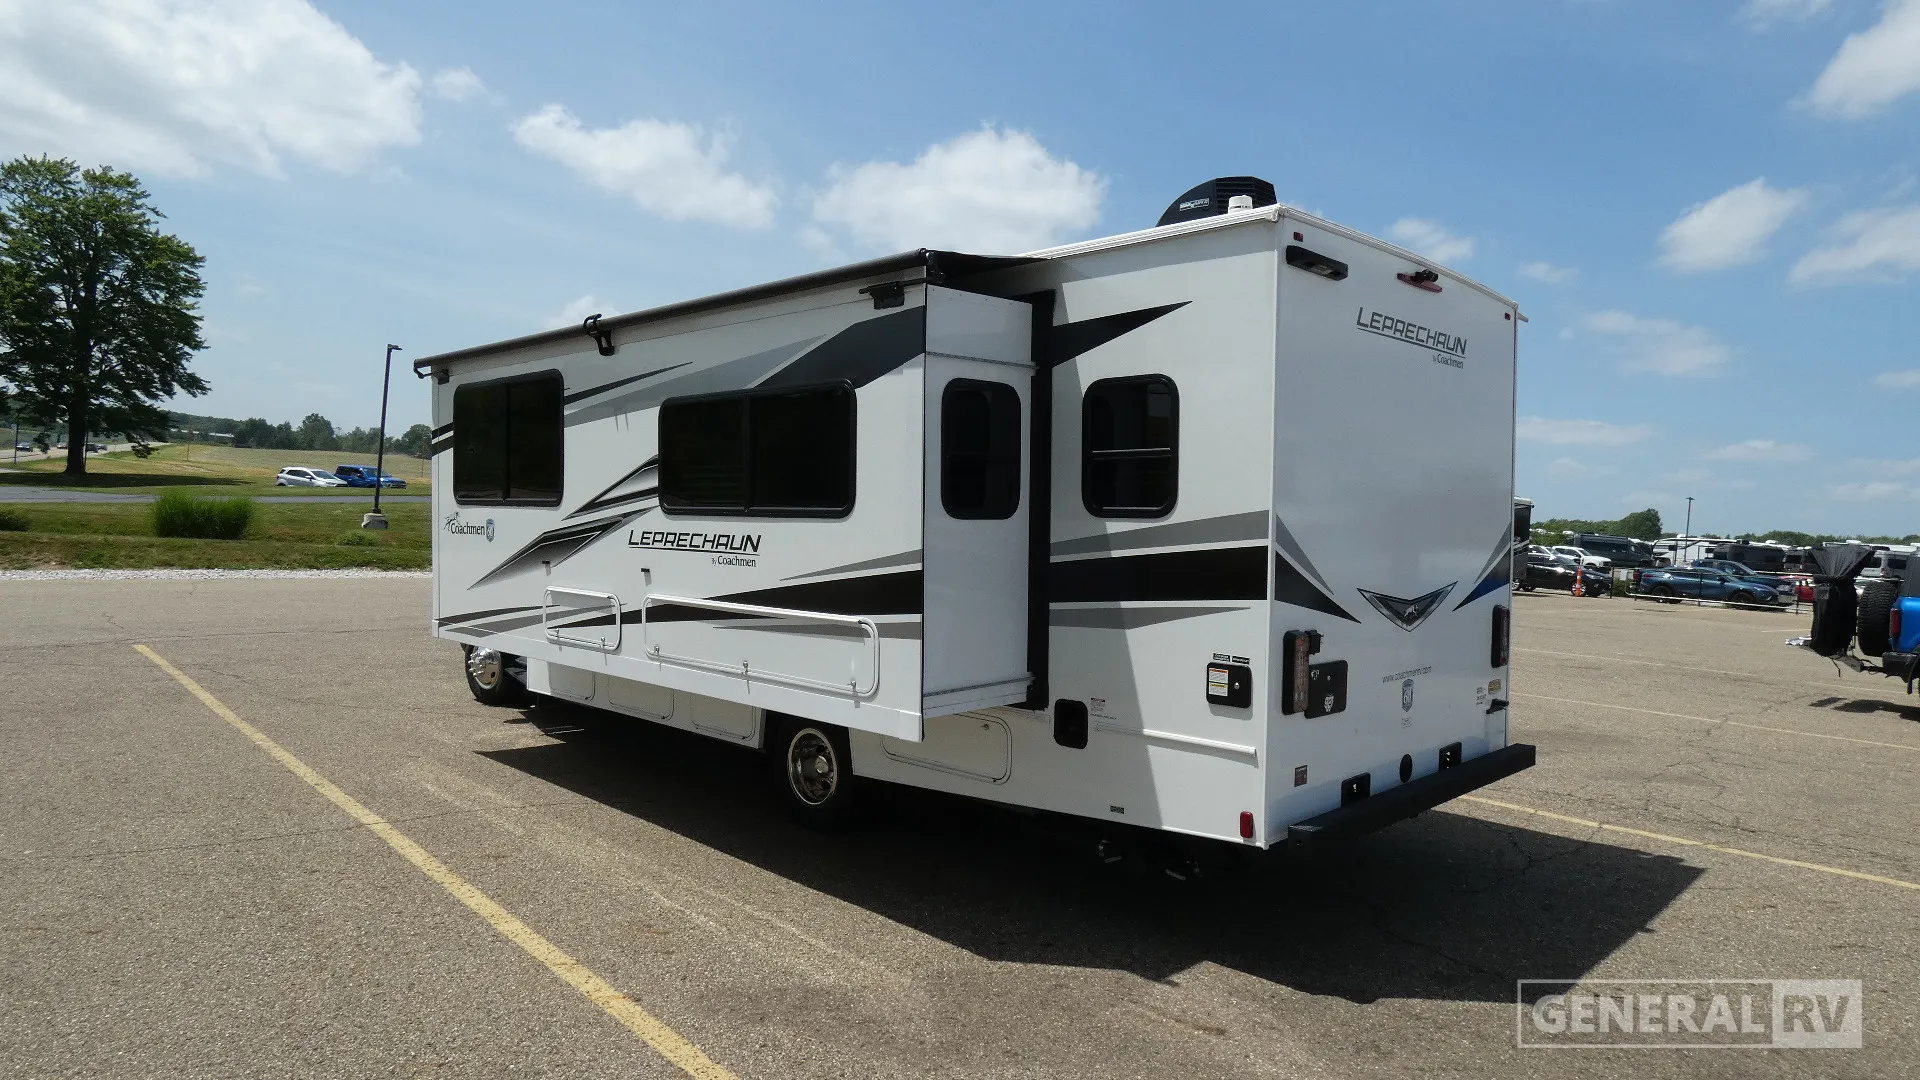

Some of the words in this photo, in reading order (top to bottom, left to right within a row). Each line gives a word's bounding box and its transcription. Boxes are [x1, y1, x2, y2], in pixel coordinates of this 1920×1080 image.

[1357, 307, 1467, 355] LEPRECHAUN
[1437, 354, 1464, 369] Coachmen
[451, 522, 485, 535] Coachmen
[628, 530, 761, 552] LEPRECHAUN
[717, 556, 756, 567] Coachmen
